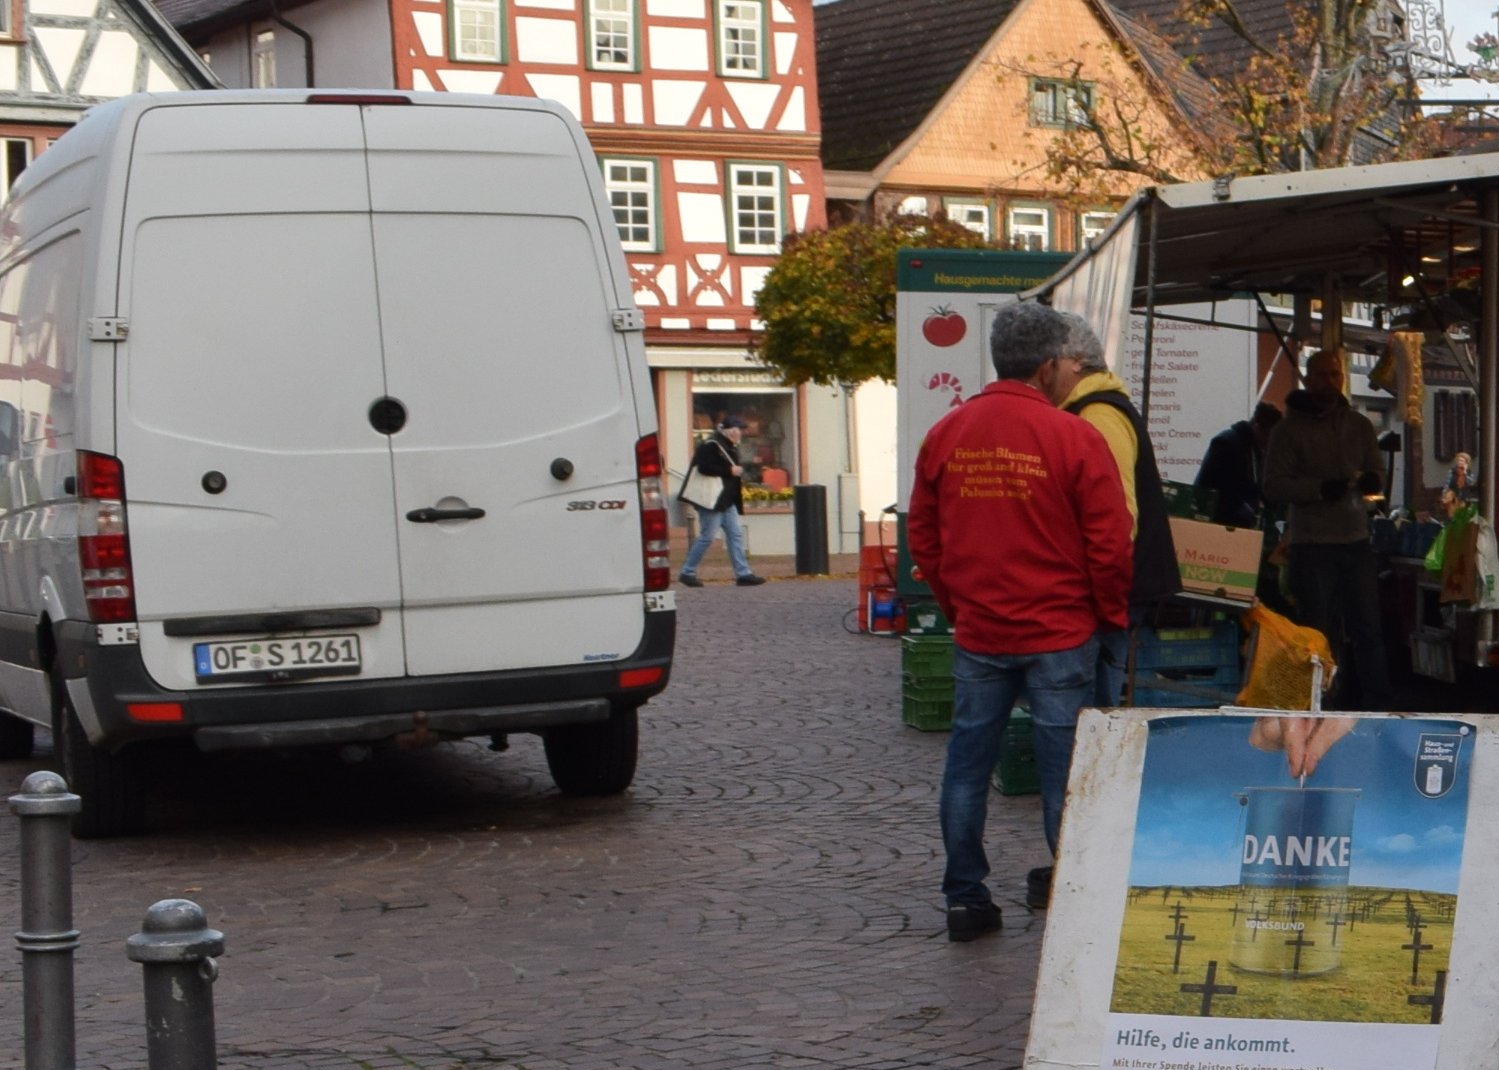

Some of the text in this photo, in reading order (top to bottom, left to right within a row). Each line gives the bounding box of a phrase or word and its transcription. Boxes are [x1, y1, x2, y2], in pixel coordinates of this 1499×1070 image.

[1156, 347, 1199, 357] Tomaten
[1167, 361, 1200, 371] Salate
[1168, 428, 1202, 438] Creme
[995, 447, 1042, 463] Blumen
[1016, 462, 1047, 477] klein
[213, 645, 248, 670] OF
[267, 643, 285, 666] S
[291, 640, 357, 665] 1261
[1242, 834, 1352, 867] DANKE
[1116, 1028, 1296, 1053] Hilfe, die ankommt.
[1112, 1057, 1129, 1067] Mit
[1131, 1058, 1158, 1069] Ihrer
